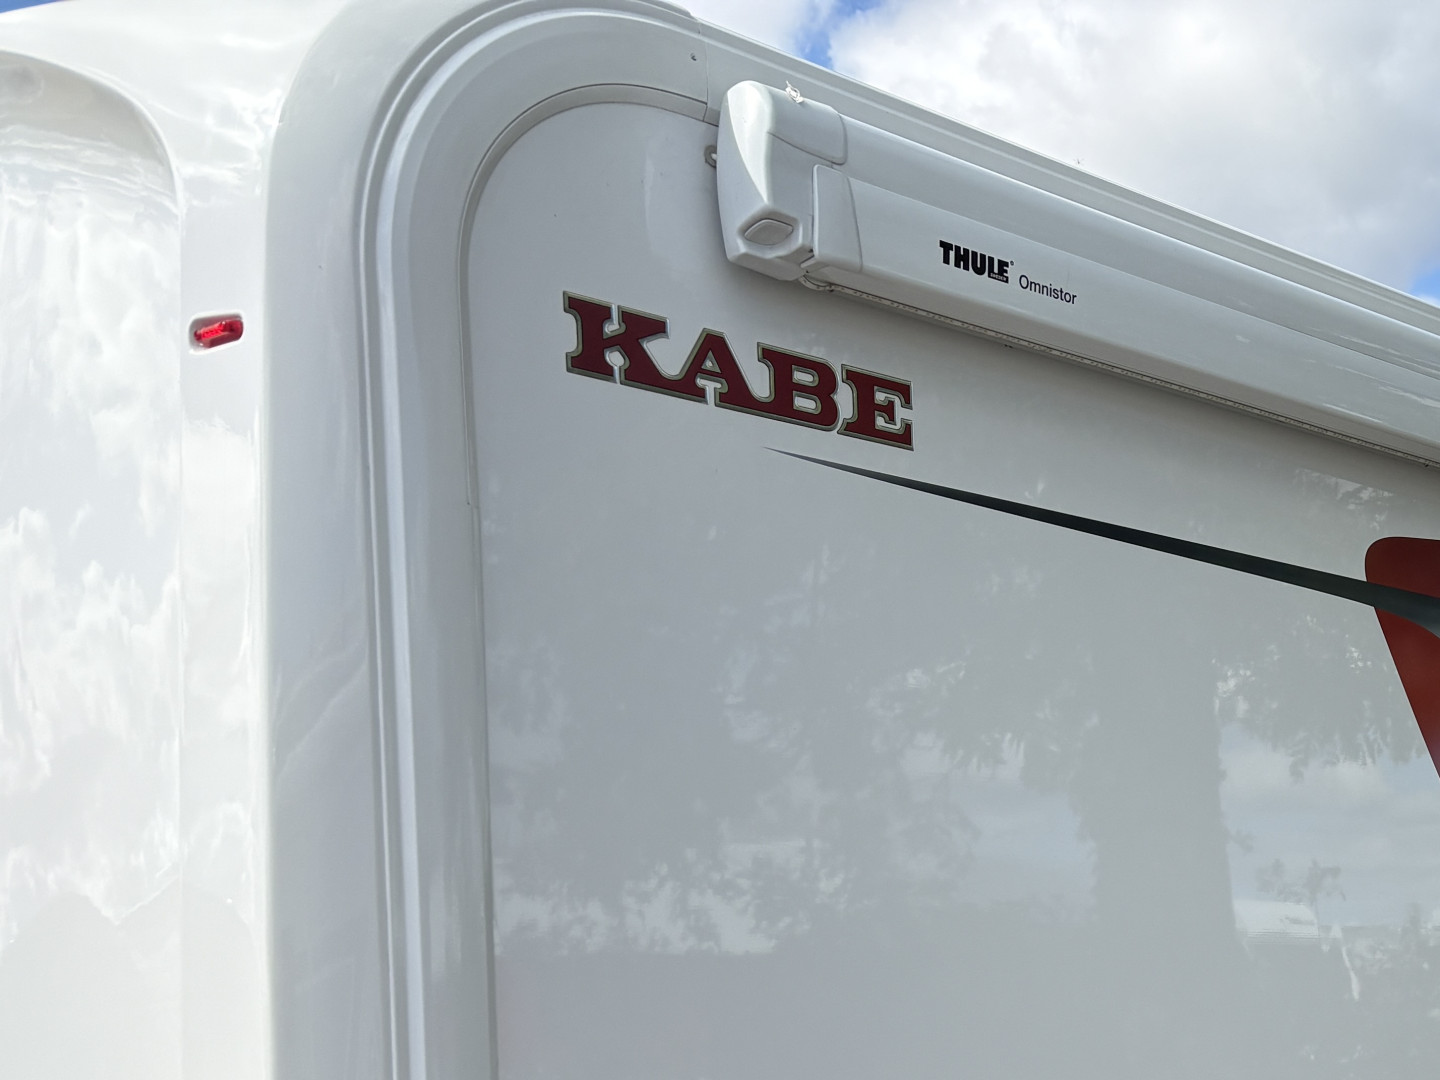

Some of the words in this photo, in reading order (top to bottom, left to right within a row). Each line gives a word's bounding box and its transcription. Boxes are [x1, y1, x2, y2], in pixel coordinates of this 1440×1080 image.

[939, 240, 1010, 284] THULE
[1018, 274, 1077, 304] Omnistor
[563, 290, 914, 451] KABE
